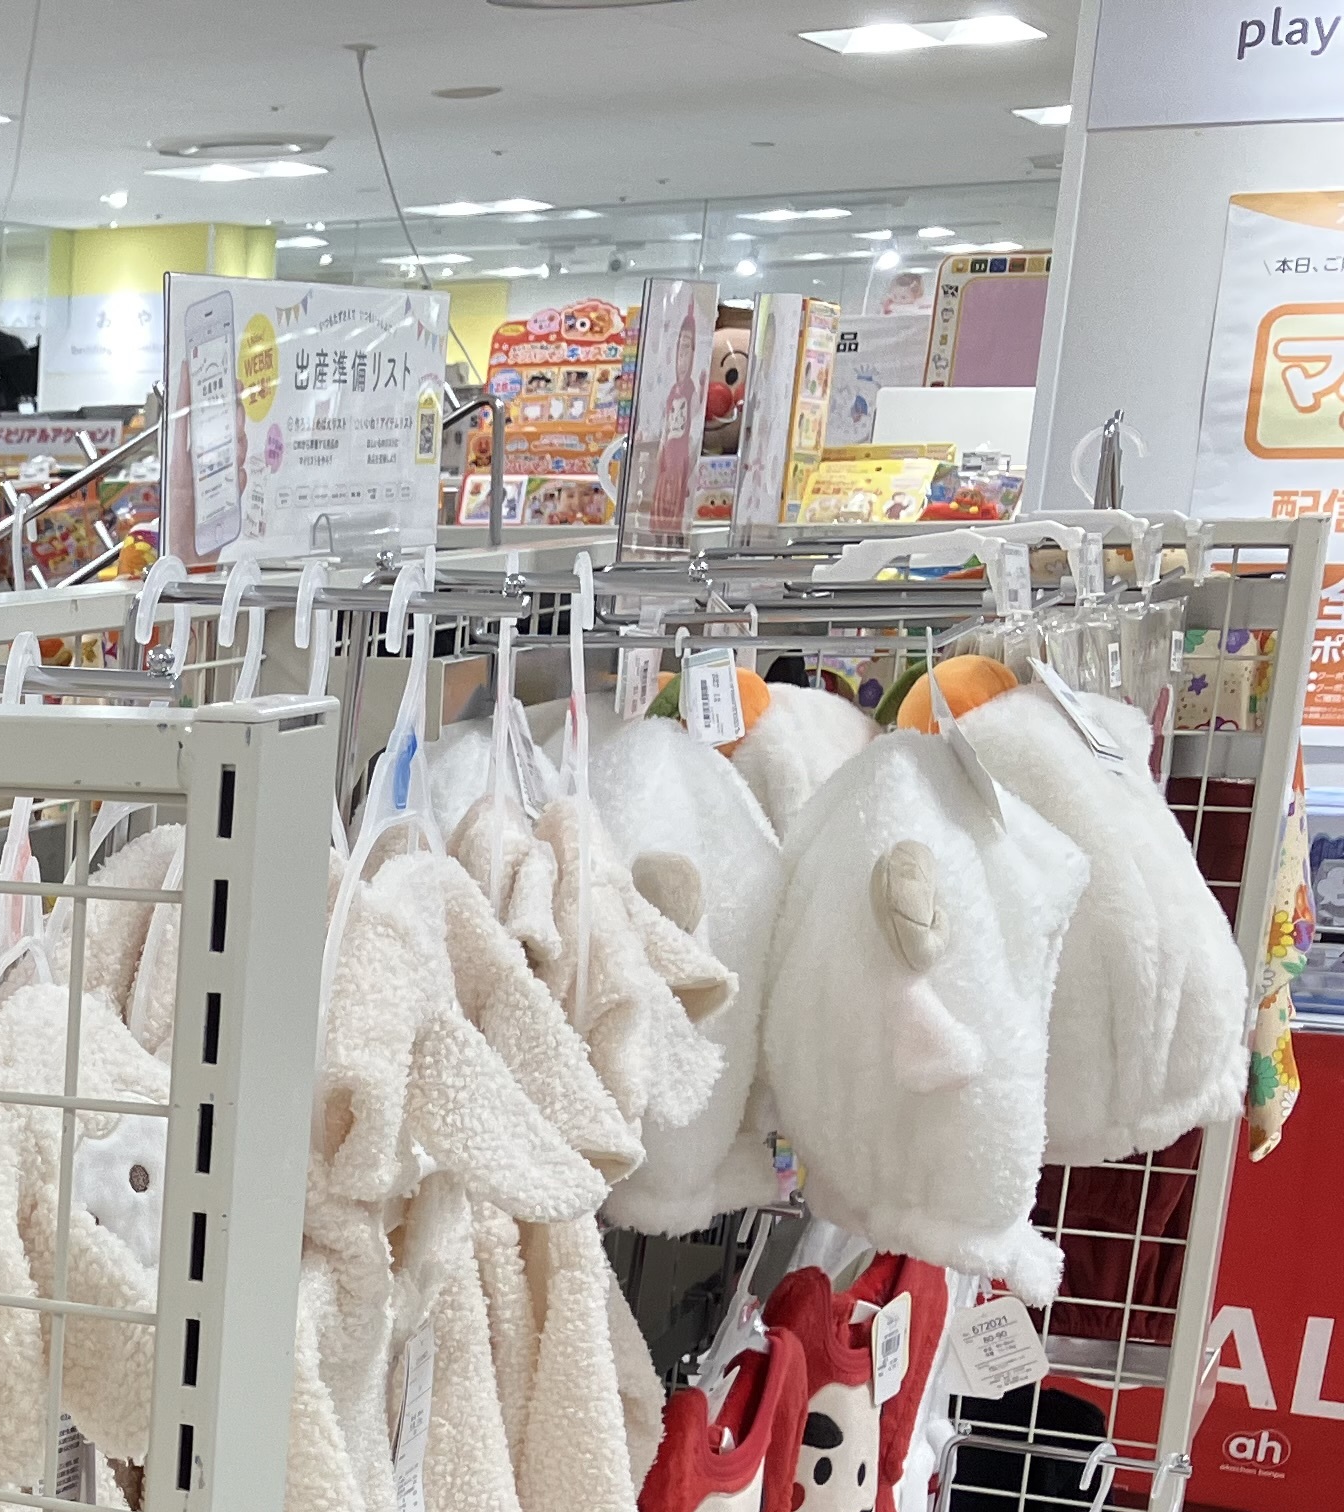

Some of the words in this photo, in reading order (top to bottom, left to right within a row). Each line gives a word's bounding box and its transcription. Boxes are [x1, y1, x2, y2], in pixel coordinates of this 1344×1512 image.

[1275, 256, 1344, 273] 本日、ご
[294, 348, 411, 392] 出産準備リスト
[1228, 1431, 1282, 1464] ah
